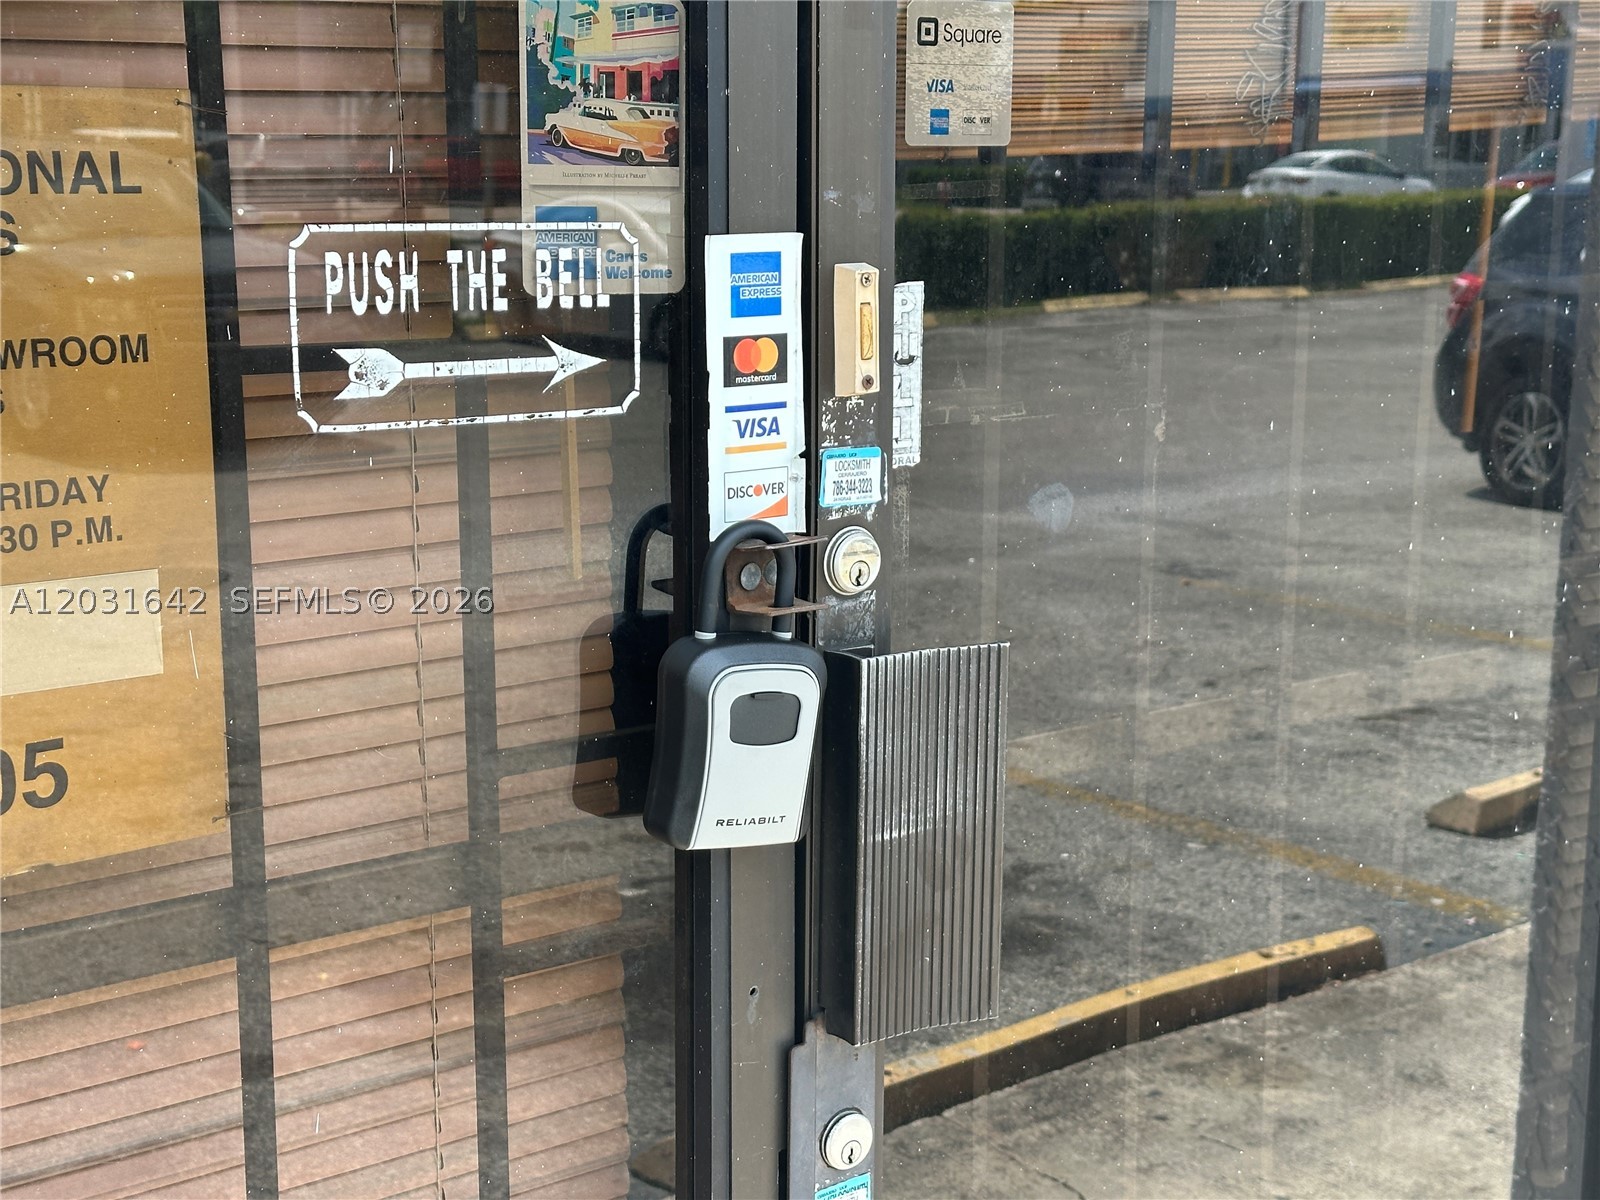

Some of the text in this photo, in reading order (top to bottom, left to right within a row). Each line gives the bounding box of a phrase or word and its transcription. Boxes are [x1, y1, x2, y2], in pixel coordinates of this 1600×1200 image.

[943, 22, 1002, 48] Square
[926, 78, 955, 93] VISA
[536, 232, 593, 243] AMERICAN
[325, 247, 610, 316] PUSH THE BELL
[731, 273, 778, 284] AMERICAN
[741, 287, 782, 298] EXPRESS
[0, 333, 149, 370] WROOM
[735, 373, 777, 384] mastercard
[732, 416, 781, 439] VISA
[834, 459, 872, 472] LOCKSMITH
[0, 474, 109, 511] RIDAY
[727, 482, 785, 500] DISCOVER
[832, 478, 873, 496] 786-344-3223
[51, 515, 123, 548] P.M.
[715, 815, 786, 827] RELIABILT
